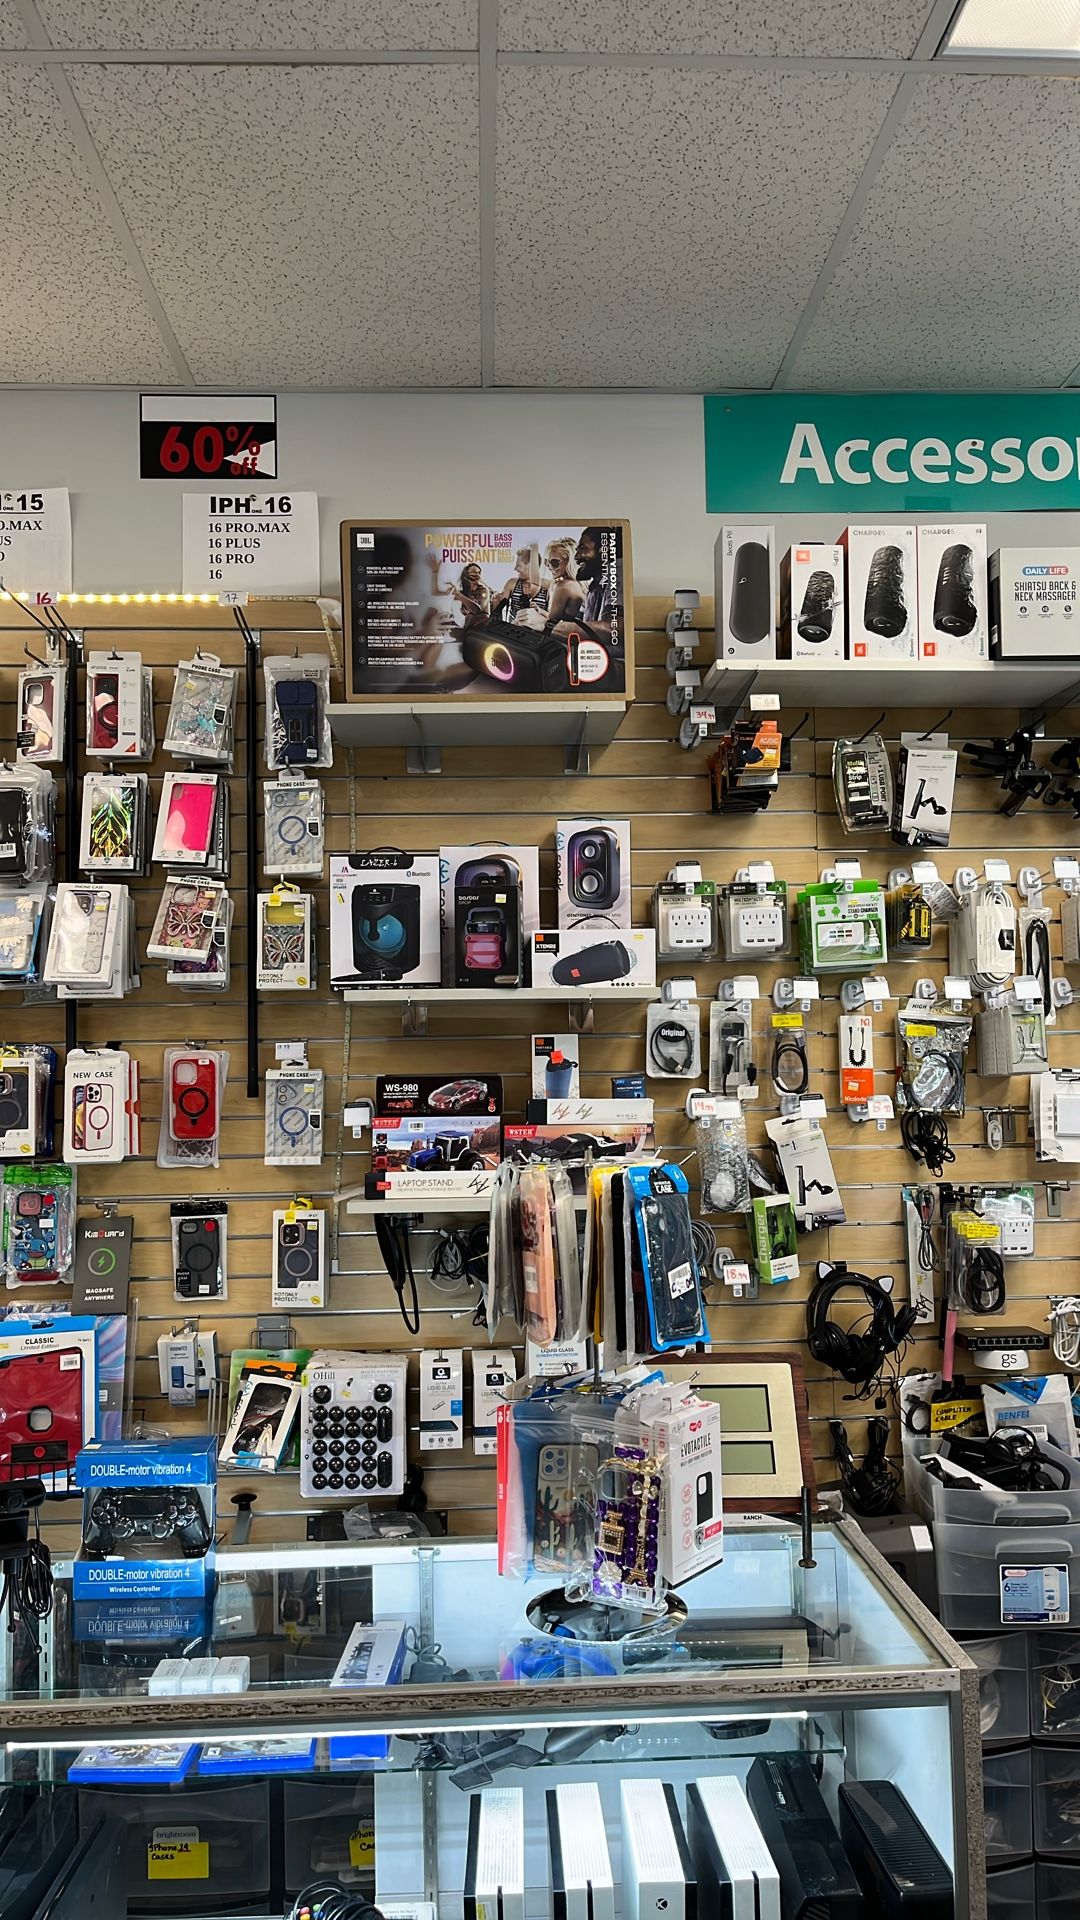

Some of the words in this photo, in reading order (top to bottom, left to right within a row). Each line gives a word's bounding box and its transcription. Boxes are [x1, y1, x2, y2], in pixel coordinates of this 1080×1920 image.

[160, 426, 261, 472] 60%
[780, 423, 1080, 484] Accesso
[230, 457, 257, 475] off
[17, 494, 43, 510] 15
[265, 496, 291, 513] 16
[209, 523, 221, 532] 16
[226, 523, 290, 532] PRO.MAX
[209, 538, 222, 548] 16
[226, 538, 261, 548] PLUS
[425, 534, 493, 548] POWERFUL
[209, 554, 222, 563] 16
[226, 554, 255, 563] PRO
[443, 549, 498, 563] PUISSANT
[600, 532, 609, 588] ESSENTIAL
[209, 569, 222, 579] 16
[1014, 581, 1047, 591] SHIATSU
[1049, 581, 1069, 590] BACK
[36, 592, 51, 604] 16
[225, 593, 238, 603] 17
[1014, 592, 1034, 601] NECK
[1036, 591, 1077, 600] MASSAGER
[191, 663, 208, 672] PHONE
[208, 666, 221, 674] CASE
[661, 1028, 686, 1037] Original
[397, 1179, 427, 1187] LAPTOP
[428, 1179, 454, 1187] STAND
[655, 1184, 674, 1194] CASE
[25, 1337, 54, 1345] CLASSIC
[1001, 1354, 1017, 1368] gs
[313, 1372, 336, 1380] OHill
[936, 1407, 971, 1416] COMPUTER
[998, 1410, 1030, 1420] BENFEI
[681, 1433, 712, 1458] EVOTACTILE
[91, 1464, 150, 1477] DOUBLE-motor
[152, 1463, 185, 1475] vibration
[186, 1463, 192, 1474] 4
[89, 1569, 148, 1581] DOUBLE-motor
[150, 1568, 183, 1580] vibration
[184, 1568, 190, 1578] 4
[133, 1585, 161, 1593] Controller
